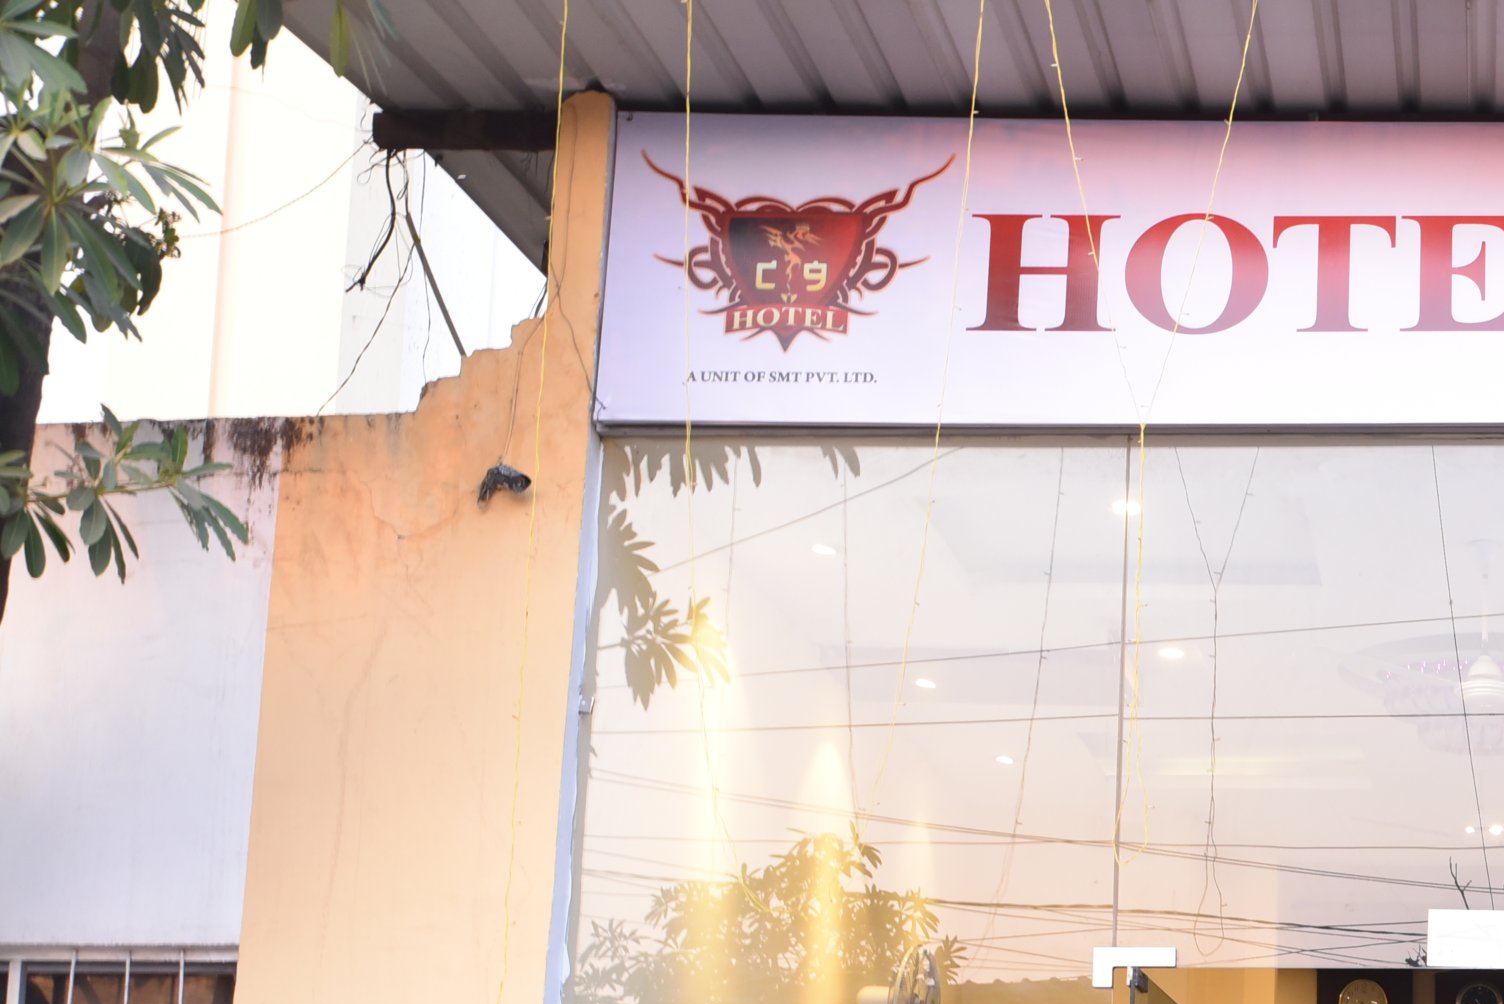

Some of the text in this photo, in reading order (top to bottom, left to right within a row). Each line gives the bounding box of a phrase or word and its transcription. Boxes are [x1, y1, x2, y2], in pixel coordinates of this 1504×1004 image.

[756, 260, 828, 292] C 9
[732, 306, 845, 331] HOTEL
[687, 371, 877, 383] A UNIT OF SMT PVT. LTD.
